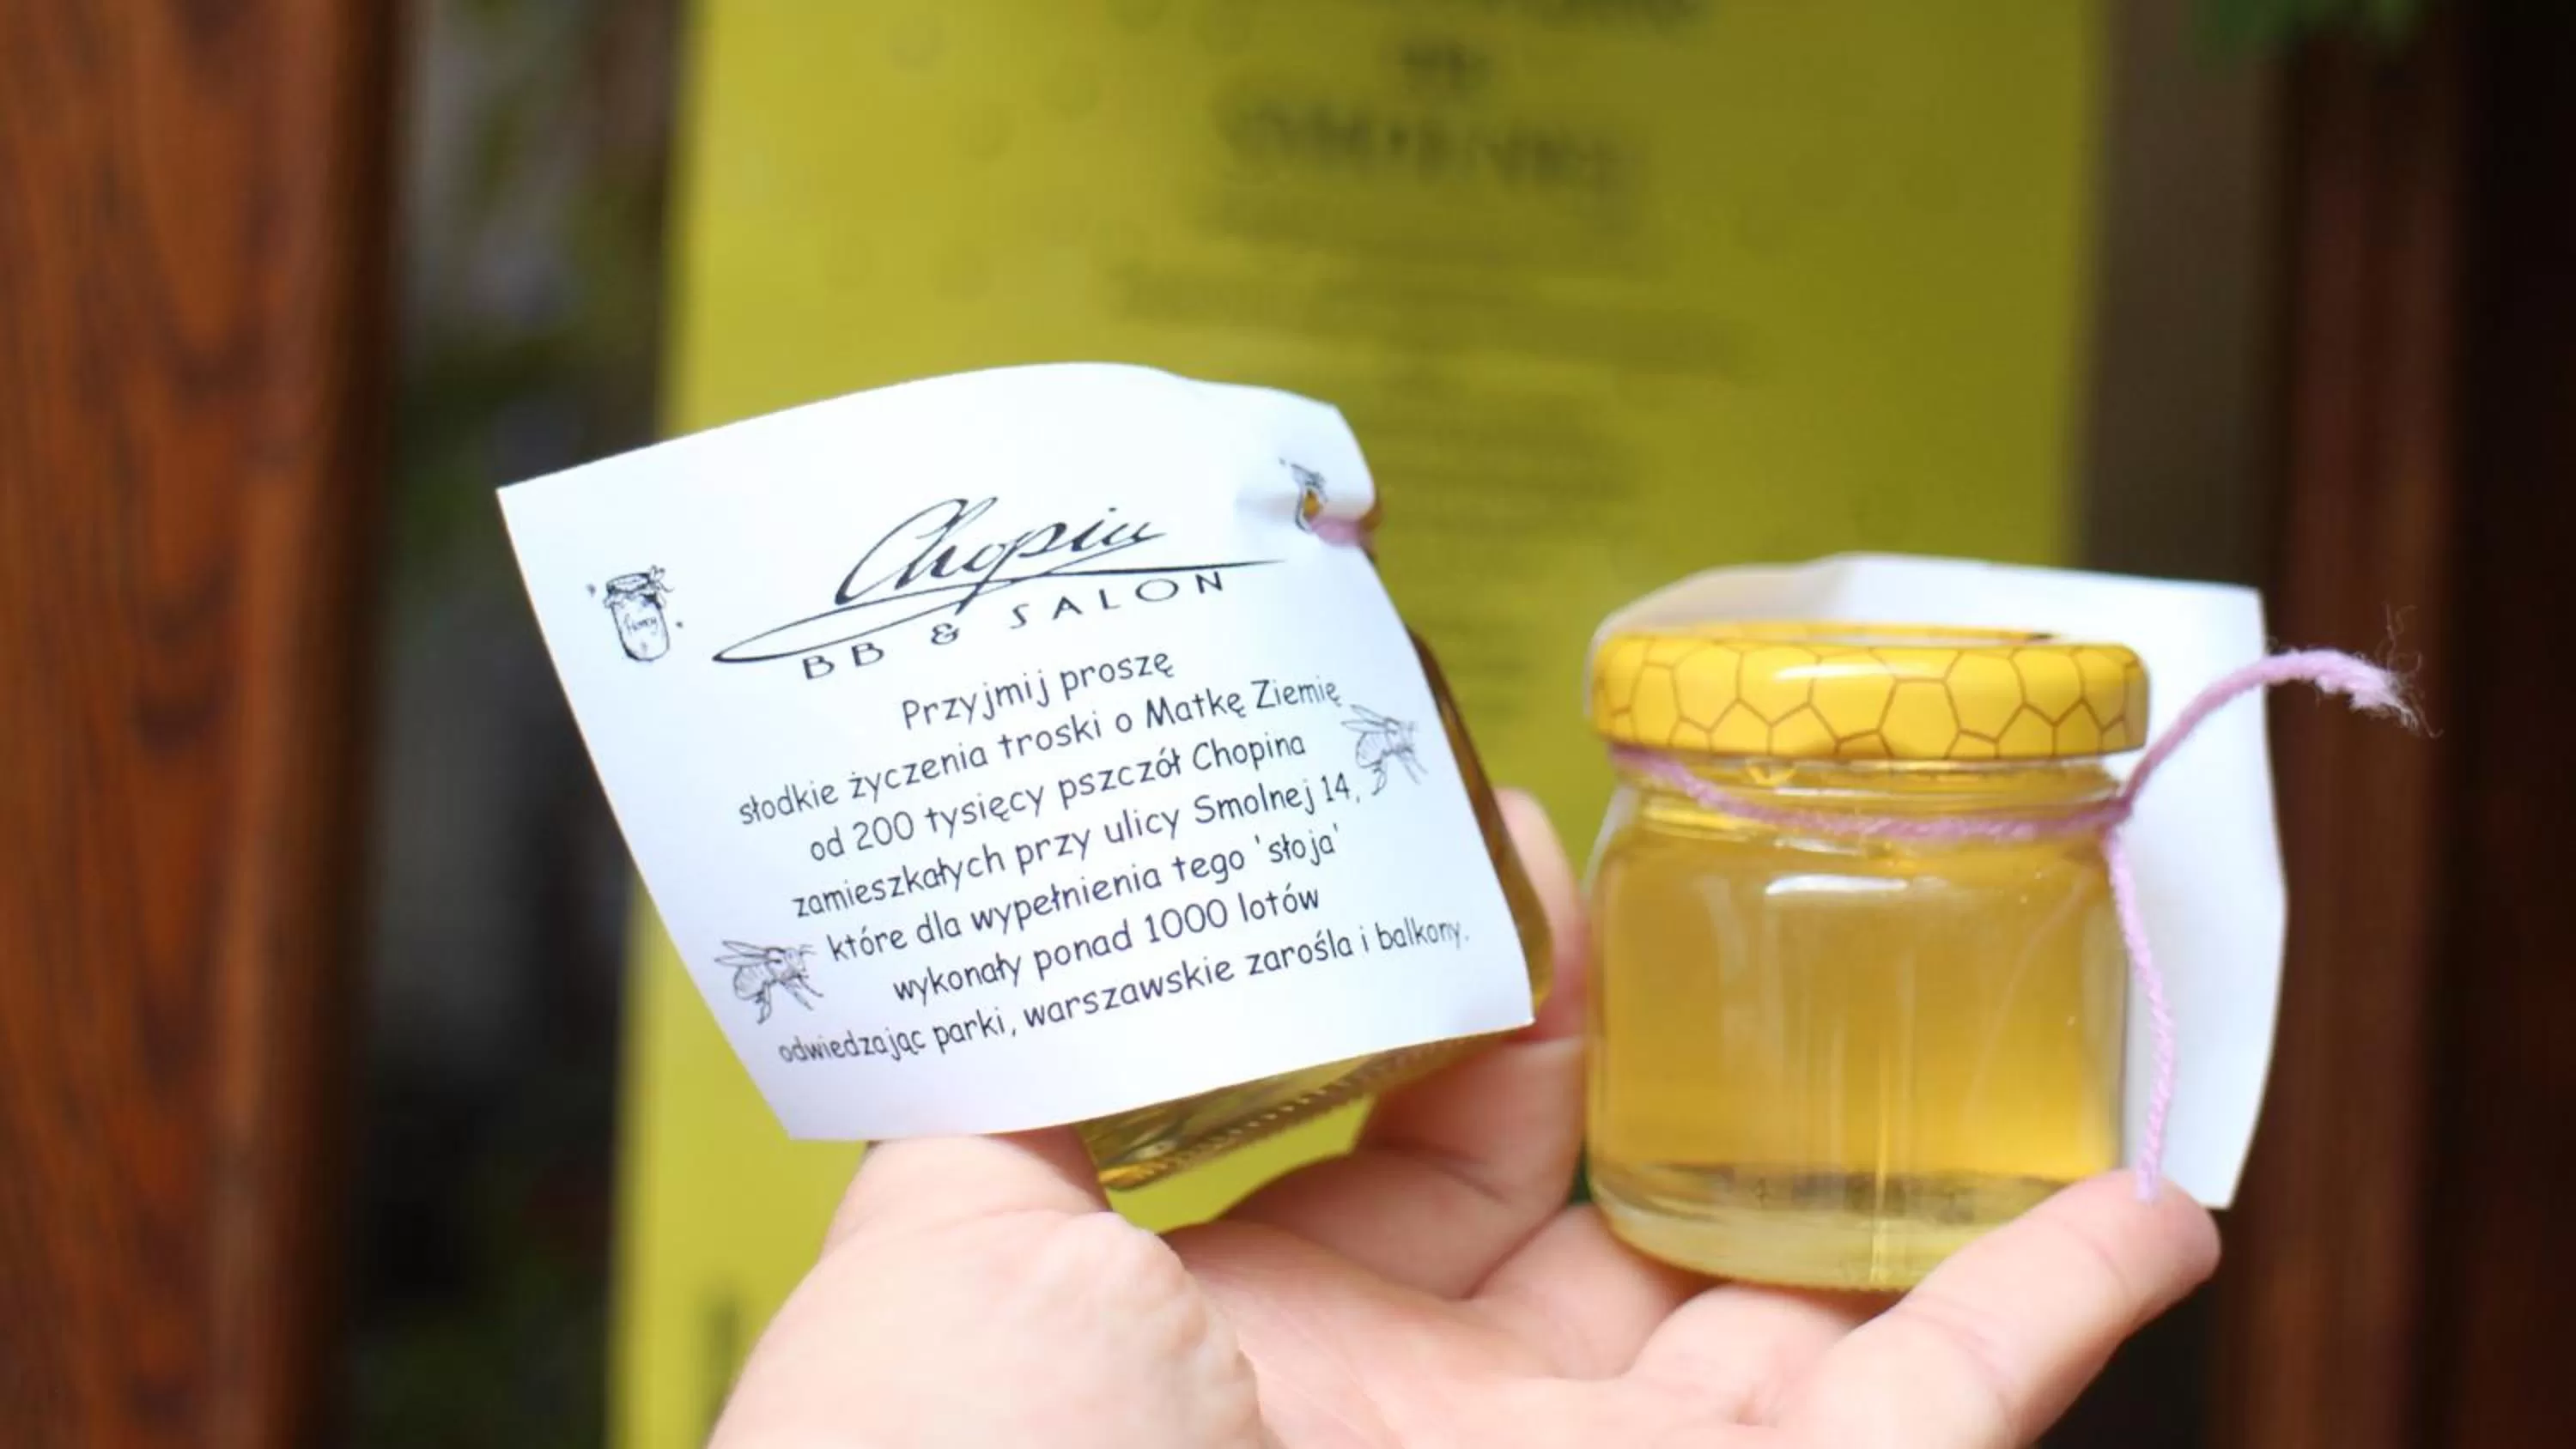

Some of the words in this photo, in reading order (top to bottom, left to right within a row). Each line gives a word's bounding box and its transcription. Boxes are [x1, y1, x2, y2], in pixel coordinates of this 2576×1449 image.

[834, 495, 1167, 615] Chopin
[802, 642, 884, 680] BB
[931, 622, 960, 646] &
[1010, 572, 1223, 629] SALON
[738, 780, 838, 825] słodkie
[848, 743, 988, 803] życzenia
[997, 711, 1102, 759] troski
[1115, 712, 1133, 733] o
[1146, 688, 1247, 729] Matkę
[1250, 676, 1342, 710] Ziemię
[902, 669, 1049, 731] Przyjmij
[1060, 652, 1175, 701] proszę
[791, 843, 1005, 919] zamieszkałych
[1015, 828, 1091, 876] przy
[1103, 809, 1180, 844] ulicy
[1194, 779, 1315, 824] Smolnej
[1321, 772, 1360, 803] 14,
[811, 826, 845, 862] od
[853, 811, 914, 851] 200
[924, 785, 1044, 839] tysięcy
[1058, 747, 1182, 810] pszczół
[1193, 731, 1306, 772] Chopina
[826, 925, 908, 961] które
[916, 910, 962, 944] dla
[970, 864, 1162, 935] wypełnienia
[1171, 850, 1245, 885] tego
[893, 952, 1021, 1007] wykonały
[1033, 918, 1133, 982] ponad
[1145, 899, 1228, 943] 1000
[1237, 882, 1319, 923] lotów
[779, 1027, 927, 1063] odwiedzając
[932, 1006, 1017, 1054] parki,
[1024, 956, 1235, 1028] warszawskie
[1244, 928, 1354, 976] zarośla
[1360, 925, 1370, 953] i
[1375, 917, 1468, 950] balkony.
